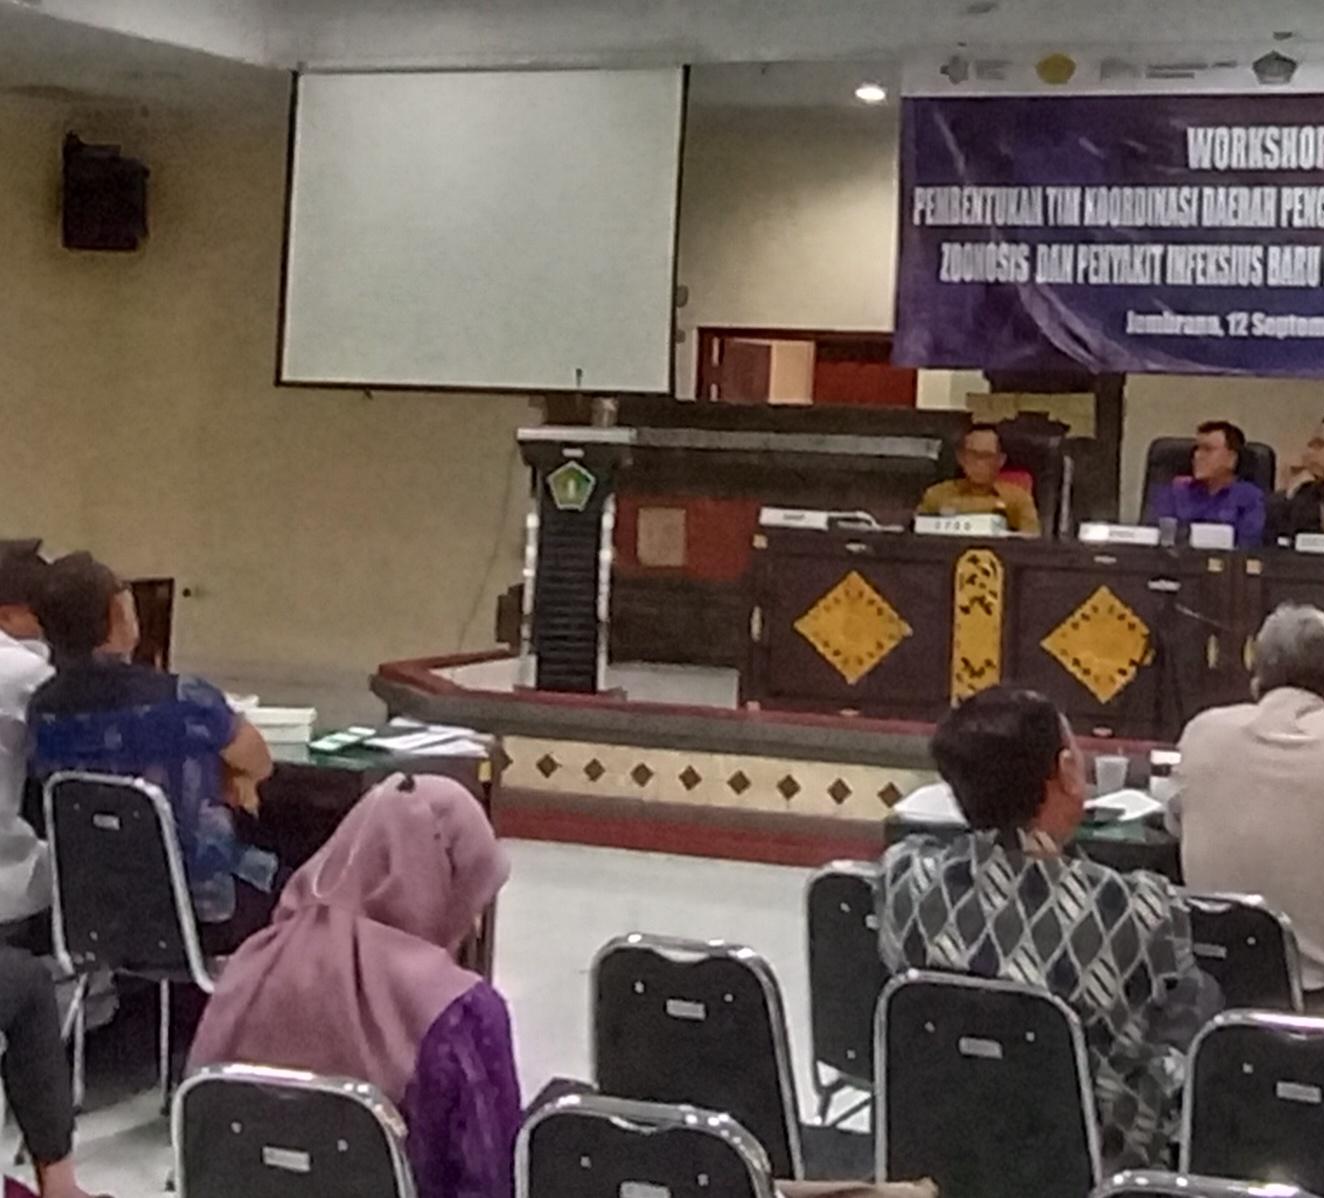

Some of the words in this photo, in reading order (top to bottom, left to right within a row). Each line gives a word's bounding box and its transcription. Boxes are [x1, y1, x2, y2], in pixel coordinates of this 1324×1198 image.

[913, 187, 1044, 227] PEMBENTUKAN
[1046, 187, 1082, 227] TIM
[1084, 187, 1200, 227] KOORDINASI
[1202, 187, 1277, 228] DAERAH
[940, 243, 1031, 283] ZOONOSIS
[1035, 243, 1074, 285] DAN
[1077, 244, 1164, 285] PENYAKIT
[1166, 244, 1264, 286] INFEKSIUS
[1267, 246, 1321, 288] BARU
[1227, 312, 1248, 336] 12
